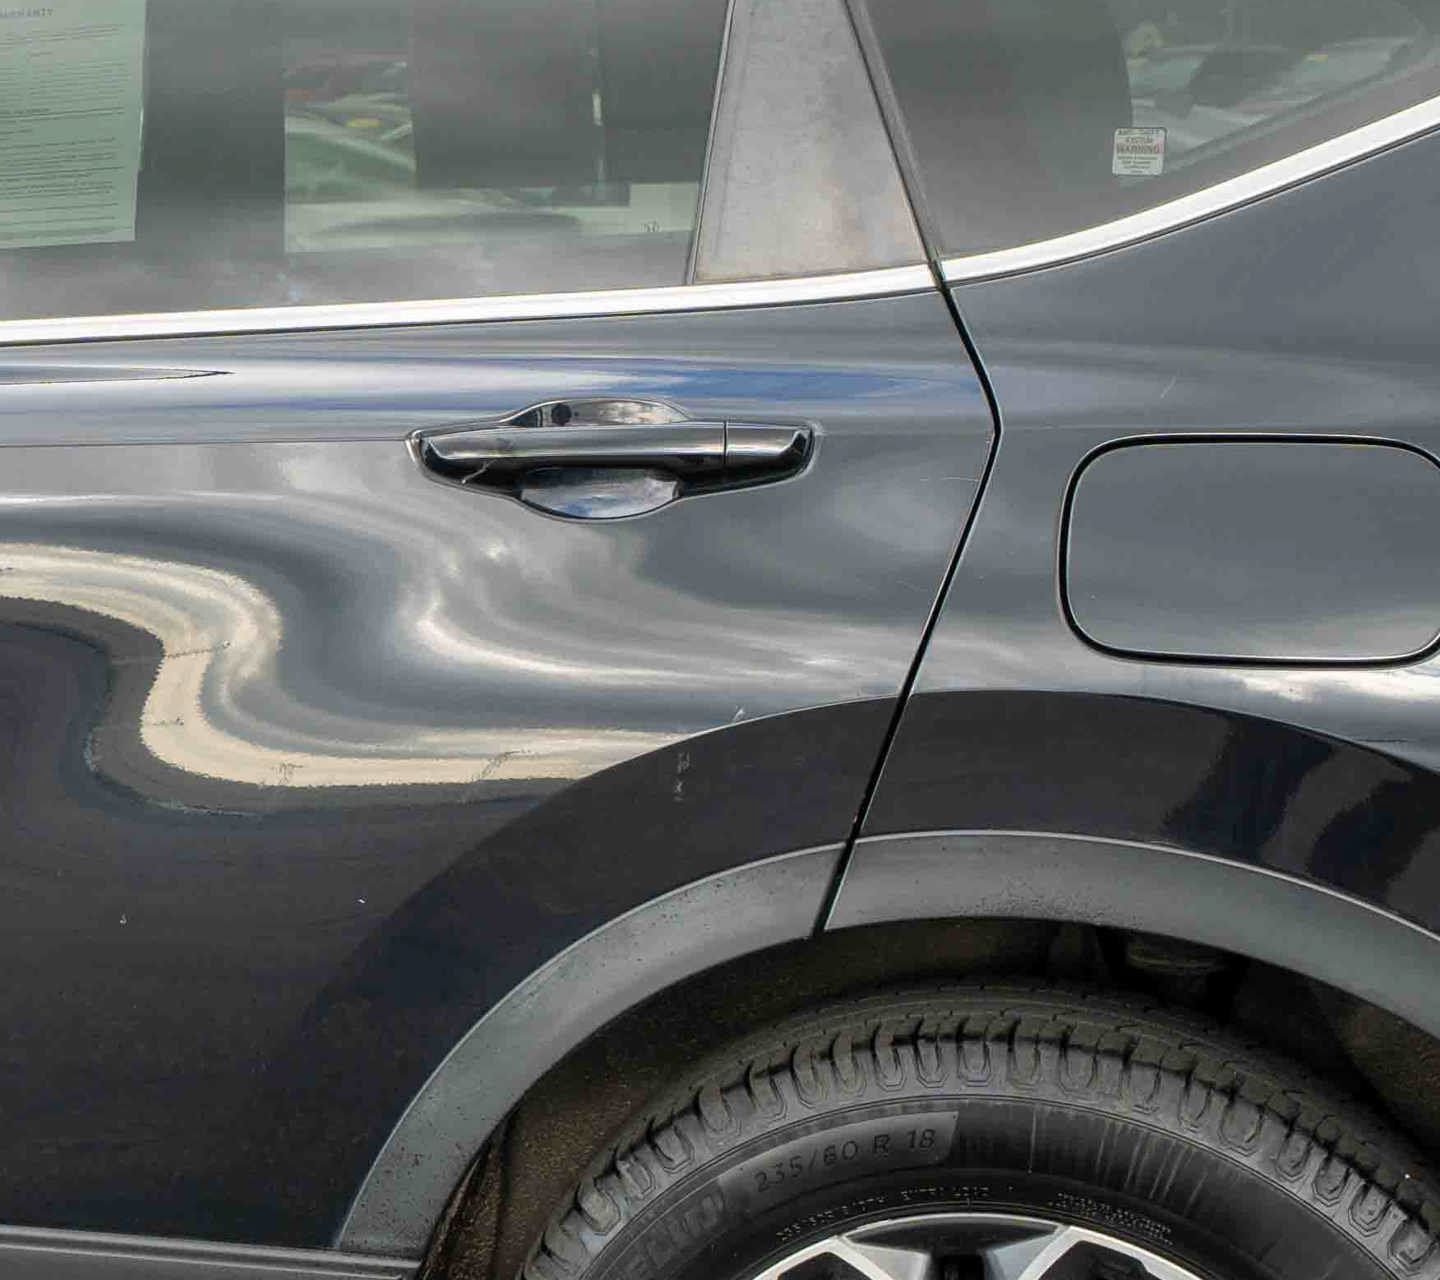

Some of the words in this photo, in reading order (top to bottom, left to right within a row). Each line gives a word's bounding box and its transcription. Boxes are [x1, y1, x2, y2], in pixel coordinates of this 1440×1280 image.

[753, 1139, 859, 1193] 235/60
[872, 1134, 891, 1158] R
[905, 1127, 937, 1151] 18
